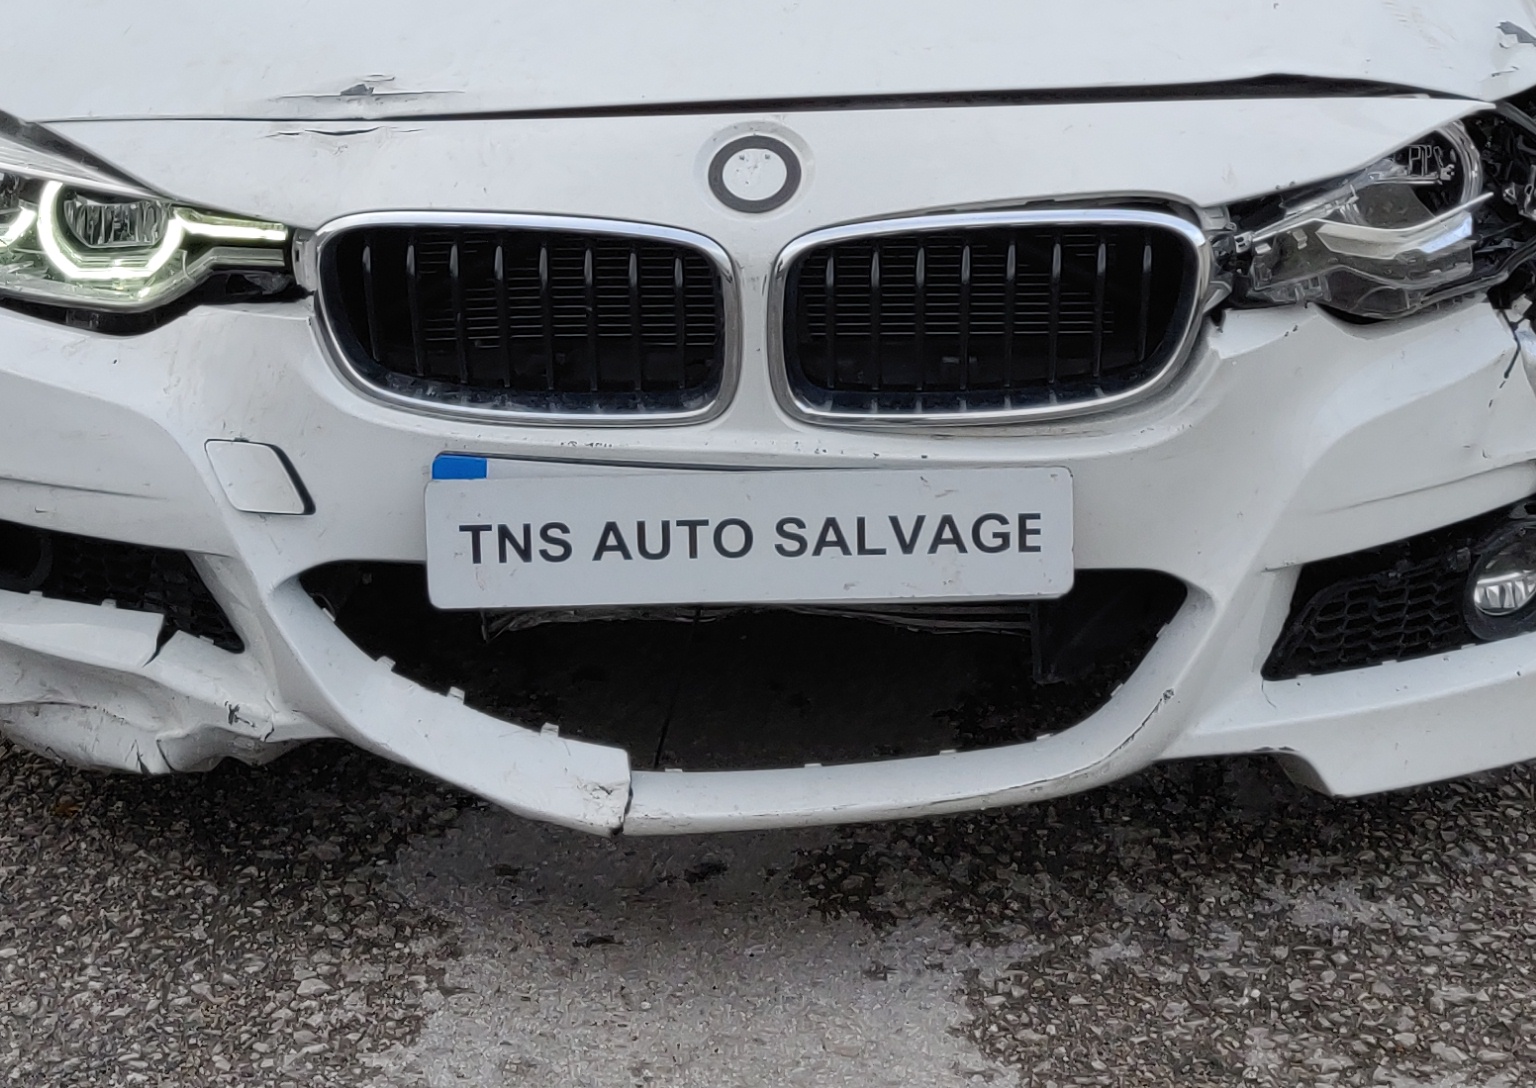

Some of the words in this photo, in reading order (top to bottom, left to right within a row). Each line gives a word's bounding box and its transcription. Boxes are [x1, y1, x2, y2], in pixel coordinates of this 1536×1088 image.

[459, 521, 573, 565] TNS
[592, 517, 755, 562] AUTO
[774, 512, 1043, 557] SALVAGE
